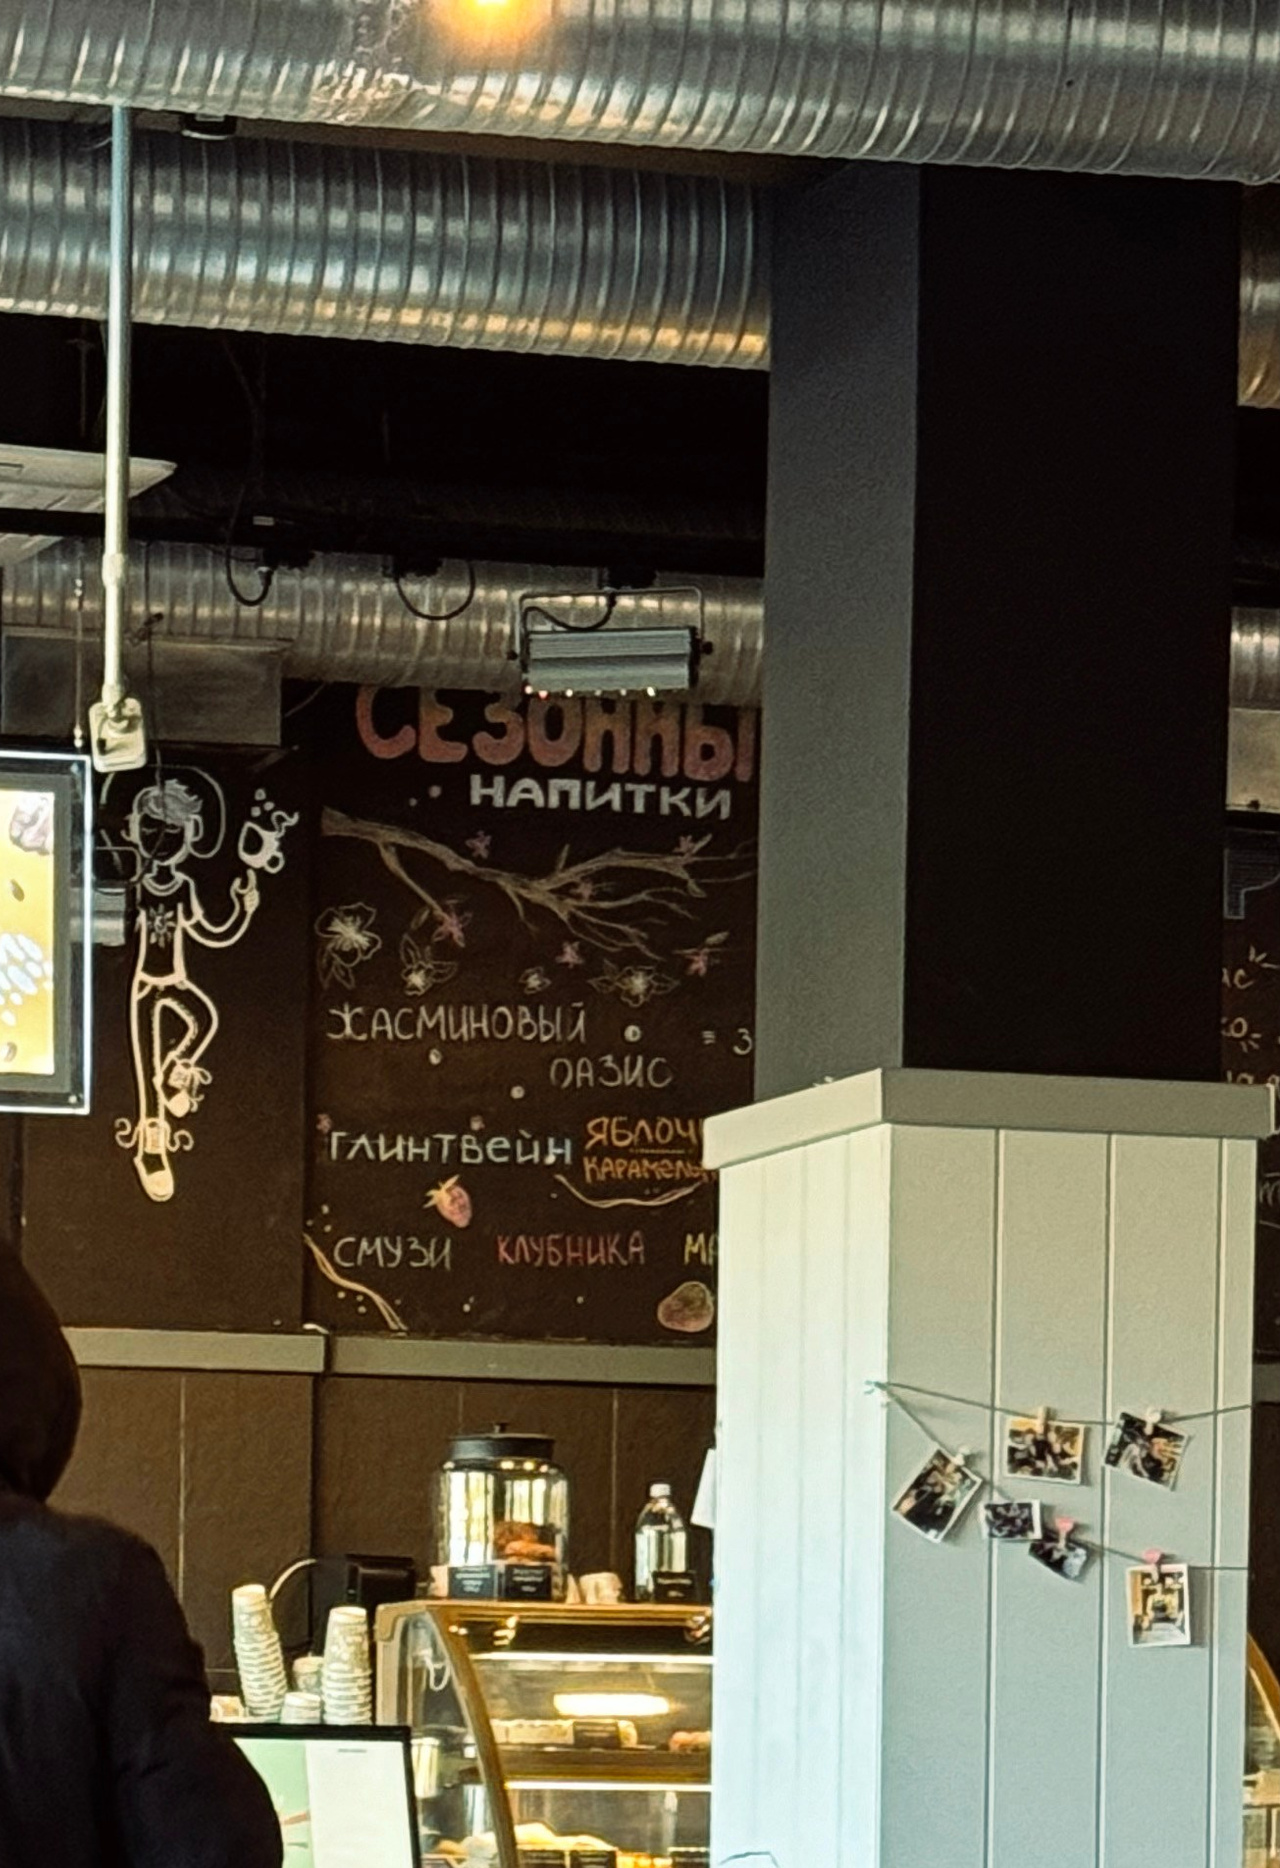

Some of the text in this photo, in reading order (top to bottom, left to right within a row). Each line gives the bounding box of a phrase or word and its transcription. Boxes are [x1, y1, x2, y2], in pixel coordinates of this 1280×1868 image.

[470, 773, 732, 821] НАПИТКИ
[326, 1002, 587, 1042] ЖАСМИНОВЫЙ
[550, 1054, 673, 1089] ОАЗИС
[584, 1115, 703, 1150] ЯБЛОЧ
[333, 1235, 452, 1271] СМУЗИ
[496, 1229, 646, 1268] КЛУБНИКА
